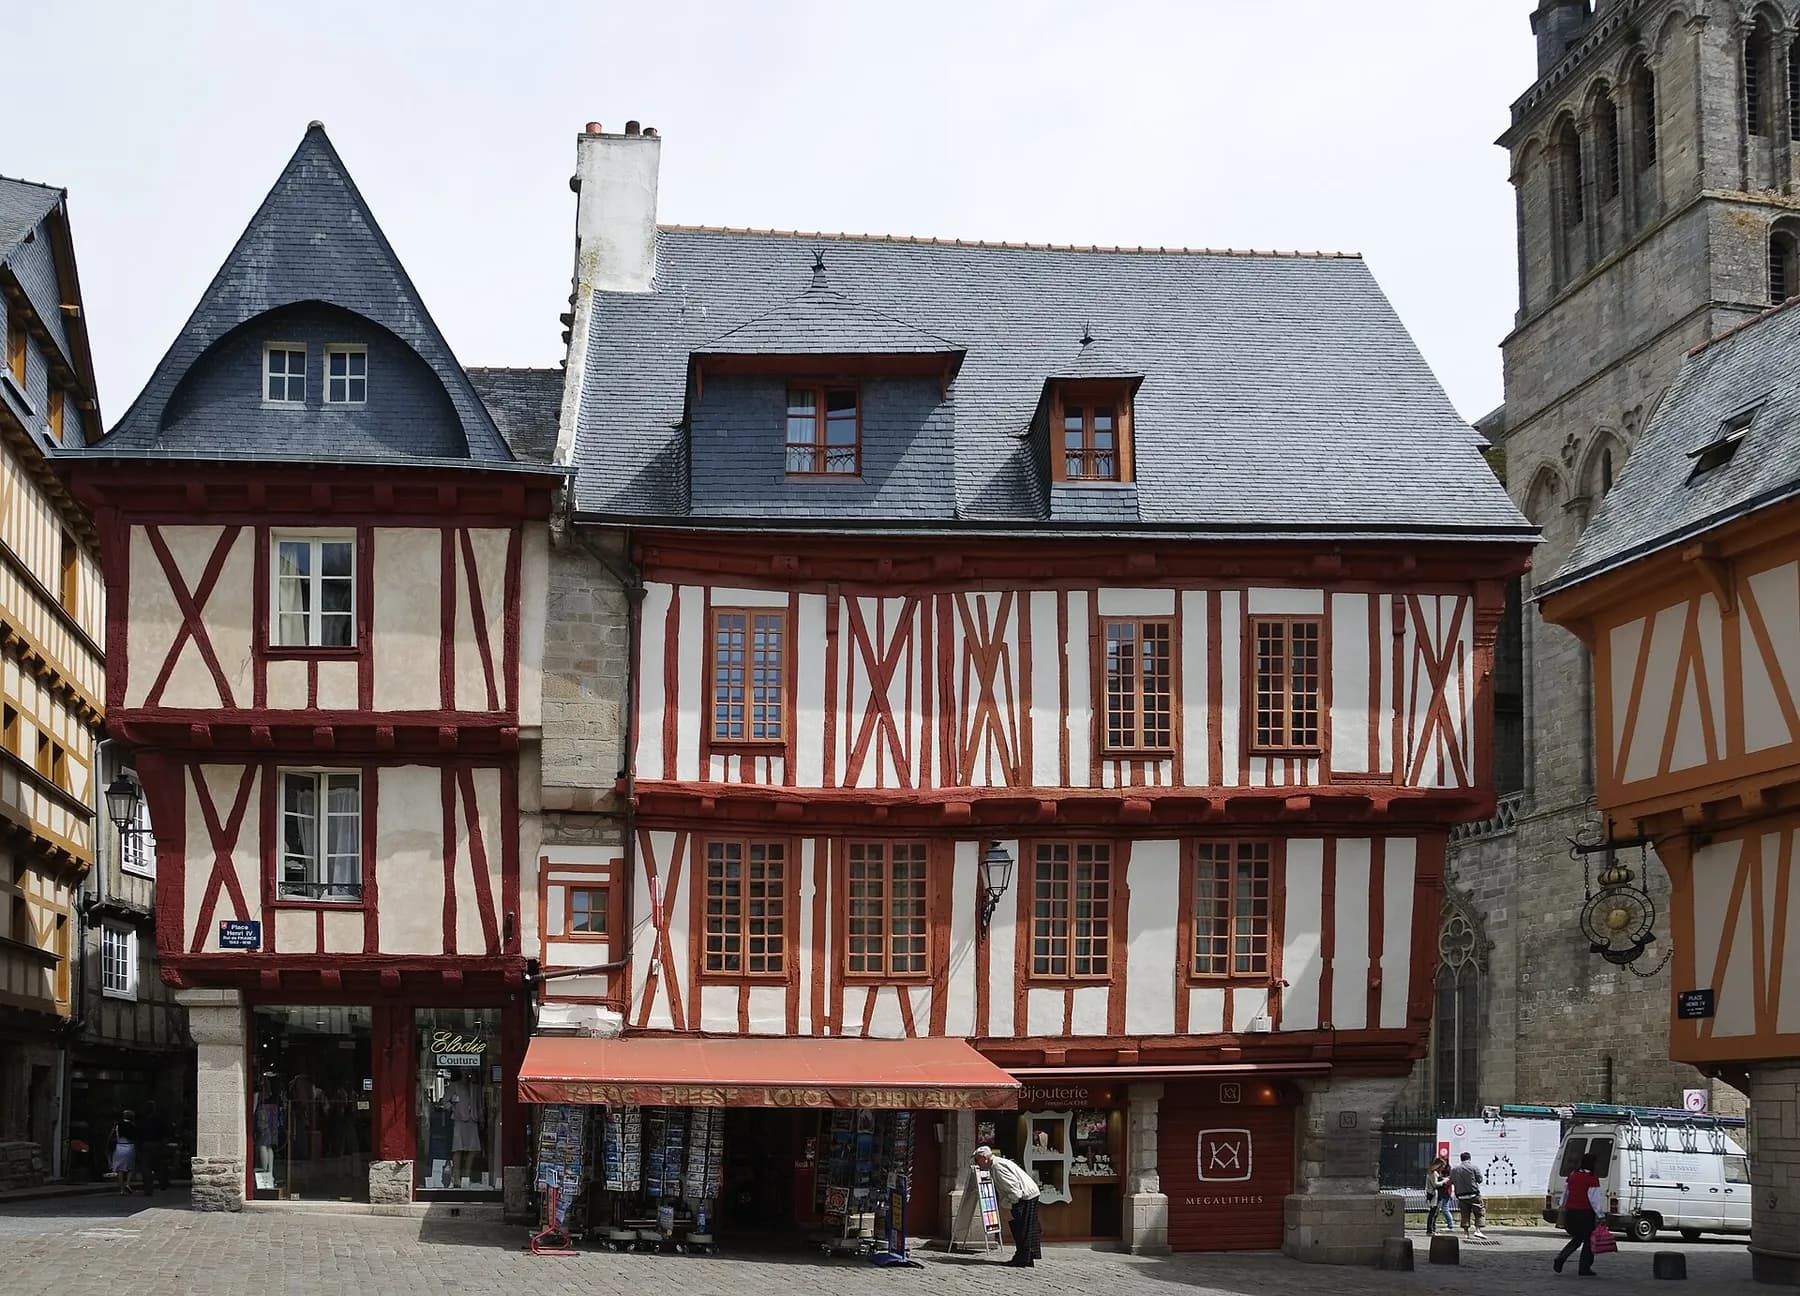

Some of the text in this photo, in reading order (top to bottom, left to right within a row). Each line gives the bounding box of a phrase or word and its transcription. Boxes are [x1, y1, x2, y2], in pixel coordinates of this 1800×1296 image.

[430, 1031, 487, 1053] Elodie
[438, 1055, 478, 1065] Couture
[763, 1088, 823, 1106] LOTO
[849, 1088, 972, 1108] JOURNAUX
[1018, 1085, 1088, 1103] Bijouterie
[1185, 1195, 1263, 1205] MEGALITHES
